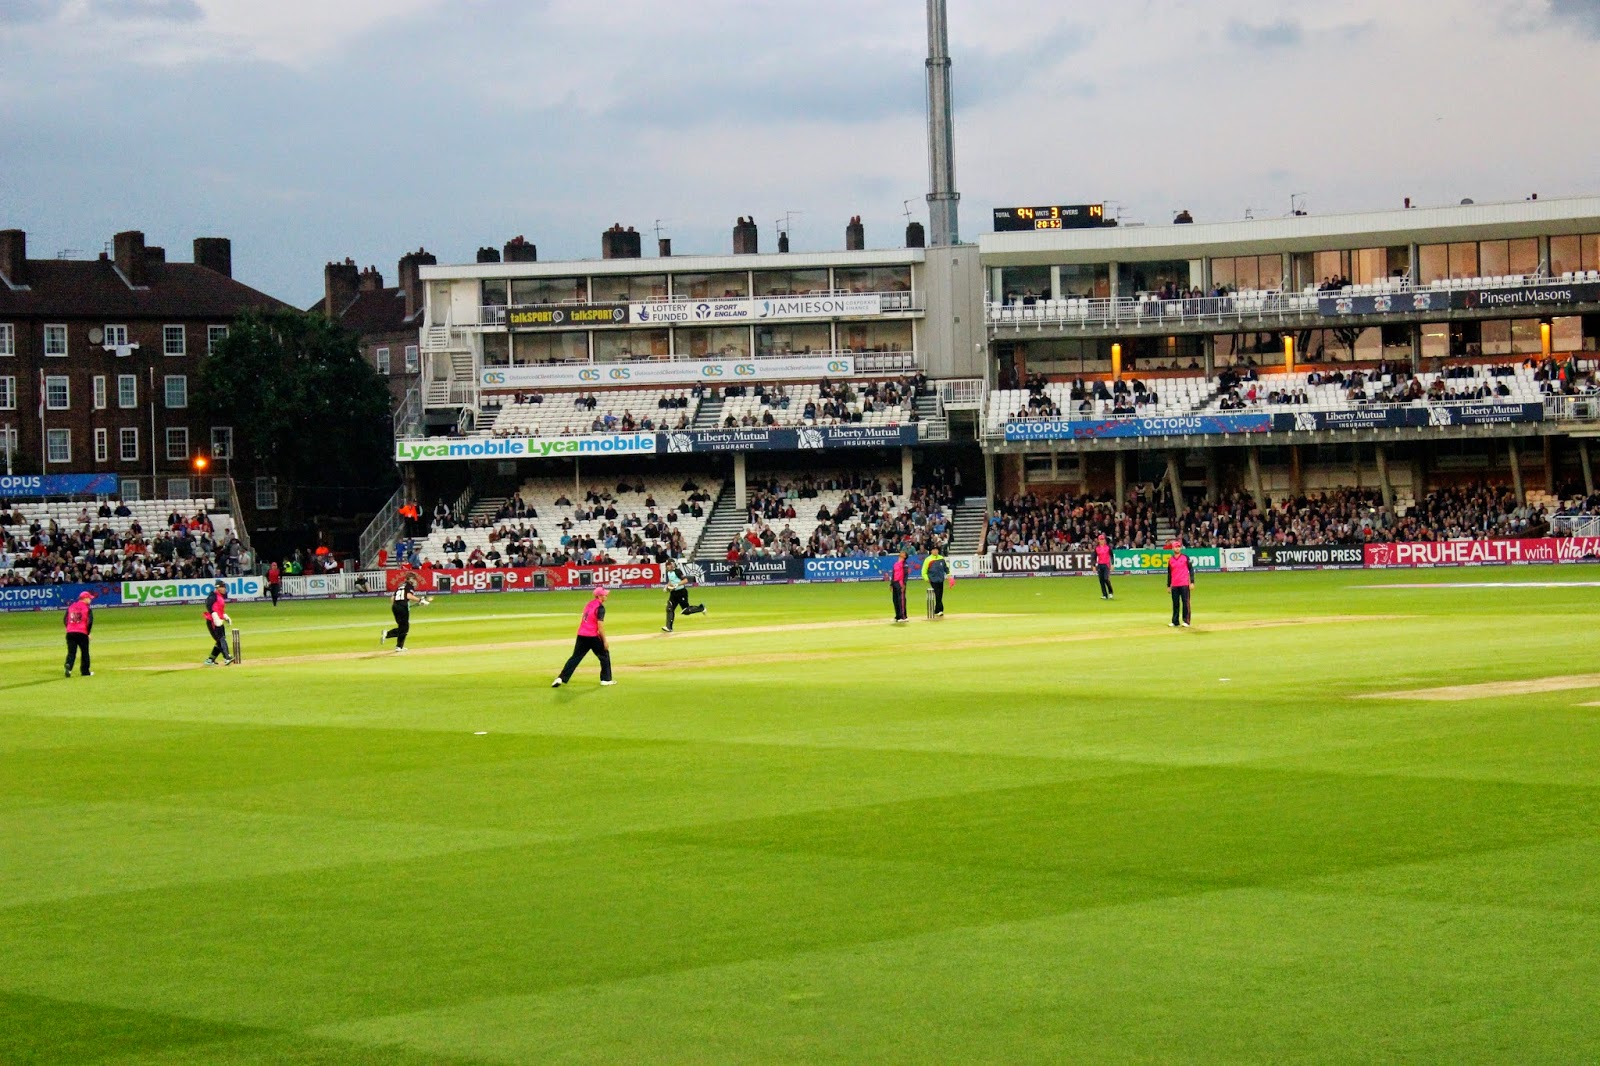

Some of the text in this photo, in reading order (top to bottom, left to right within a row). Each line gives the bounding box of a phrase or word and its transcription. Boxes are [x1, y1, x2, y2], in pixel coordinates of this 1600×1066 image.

[1017, 208, 1033, 219] 94
[1051, 207, 1059, 219] 3
[1090, 206, 1102, 217] 14
[1480, 289, 1572, 304] Pinsent Masons
[652, 304, 688, 312] LOTTERY
[714, 303, 738, 311] SPORT
[772, 301, 844, 316] JAMIESON
[510, 311, 553, 323] talkSPORT
[571, 309, 613, 322] talkSPORT
[652, 312, 689, 321] FUNDED
[714, 310, 749, 318] ENGLAND
[1325, 410, 1386, 422] Liberty Mutual
[1460, 404, 1522, 417] Liberty Mutual
[1006, 422, 1069, 434] OCTOPUS
[1143, 417, 1202, 430] OCTOPUS
[697, 430, 769, 444] Liberty Mutual
[829, 427, 901, 440] Liberty Mutual
[1149, 428, 1196, 436] INVESTMENTS
[399, 438, 524, 460] Lycamobile
[528, 435, 655, 457] Lycamobile
[0, 476, 41, 489] OPUS
[1275, 548, 1362, 563] STOWFORD PRESS
[1396, 538, 1600, 563] PRUHEALTH with Vitalit
[710, 561, 786, 574] Libey Mutual
[807, 560, 870, 573] OCTOPUS
[995, 554, 1073, 571] YORKSHIRE
[432, 570, 518, 591] Pdigre
[568, 566, 654, 588] Pdigree
[813, 570, 864, 578] INVESTMENTS
[123, 577, 259, 603] Lycamoile
[395, 589, 405, 601] 21
